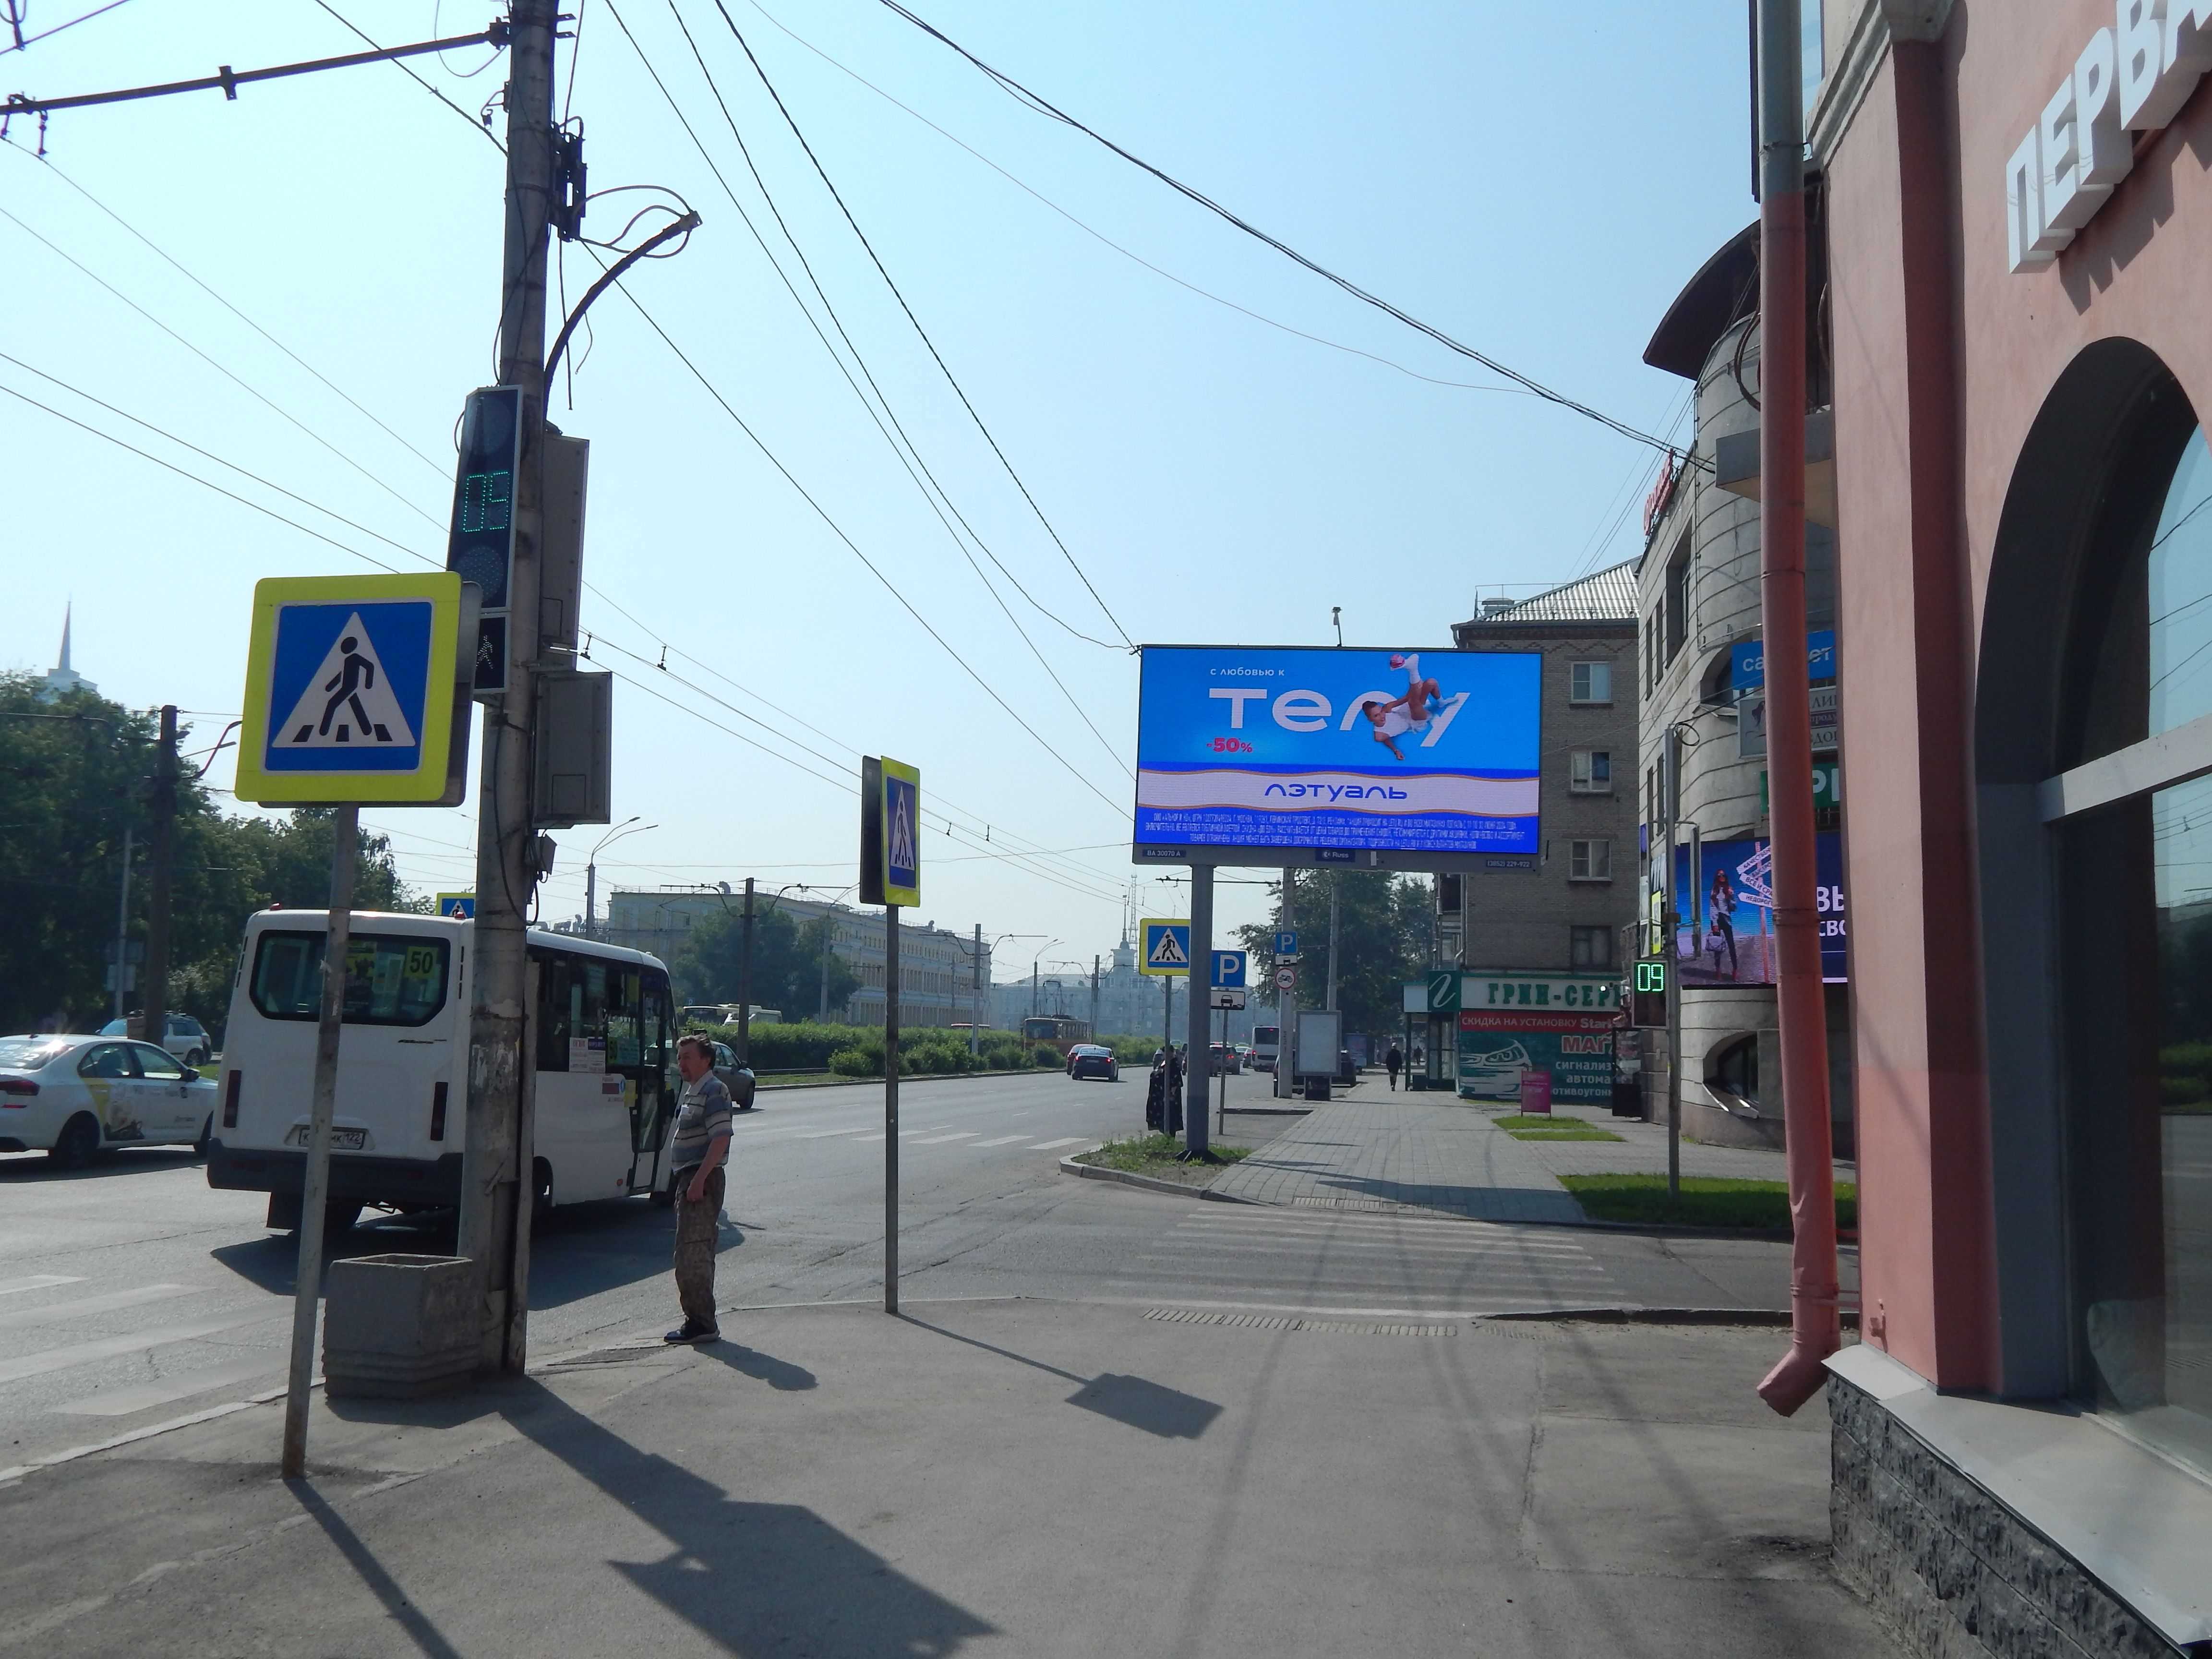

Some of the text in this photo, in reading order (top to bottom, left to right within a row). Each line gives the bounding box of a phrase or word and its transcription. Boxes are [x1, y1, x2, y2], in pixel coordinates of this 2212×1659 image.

[1220, 667, 1274, 676] любовью
[1206, 737, 1253, 753] -50%
[1281, 934, 1293, 950] P
[409, 951, 433, 974] 50
[1219, 954, 1239, 983] P
[1637, 963, 1664, 991] 09
[1462, 1017, 1502, 1027] СКИДКА
[1520, 1019, 1576, 1028] УСТАНОВКУ
[1562, 1035, 1612, 1055] МАГ
[1555, 1061, 1612, 1070] сигнализ
[1566, 1075, 1611, 1084] автома
